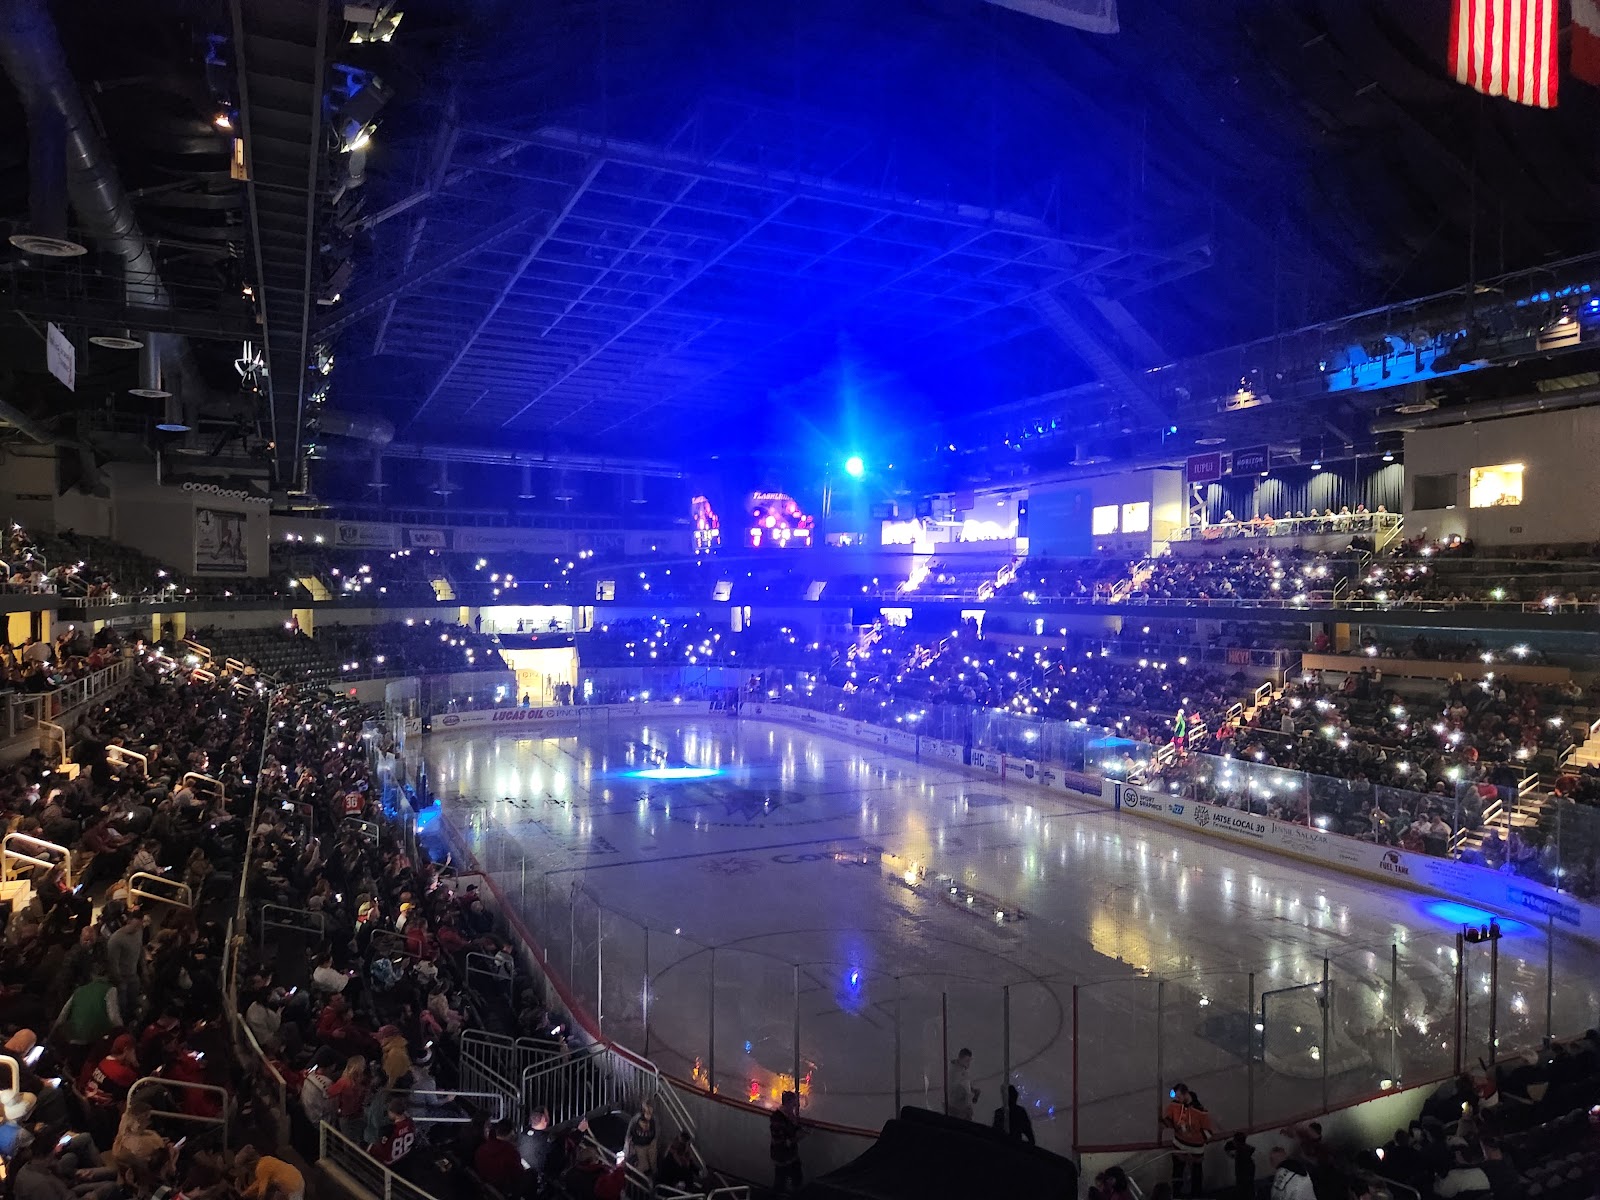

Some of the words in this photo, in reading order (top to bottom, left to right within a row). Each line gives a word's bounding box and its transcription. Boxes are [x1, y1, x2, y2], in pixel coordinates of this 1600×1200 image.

[493, 710, 526, 721] LUCAS
[527, 709, 545, 719] OIL
[1212, 813, 1232, 825] IATSE
[1232, 818, 1255, 830] LOCAL
[1256, 824, 1265, 833] 30
[1379, 861, 1394, 872] FUEL
[1395, 865, 1409, 875] TANK
